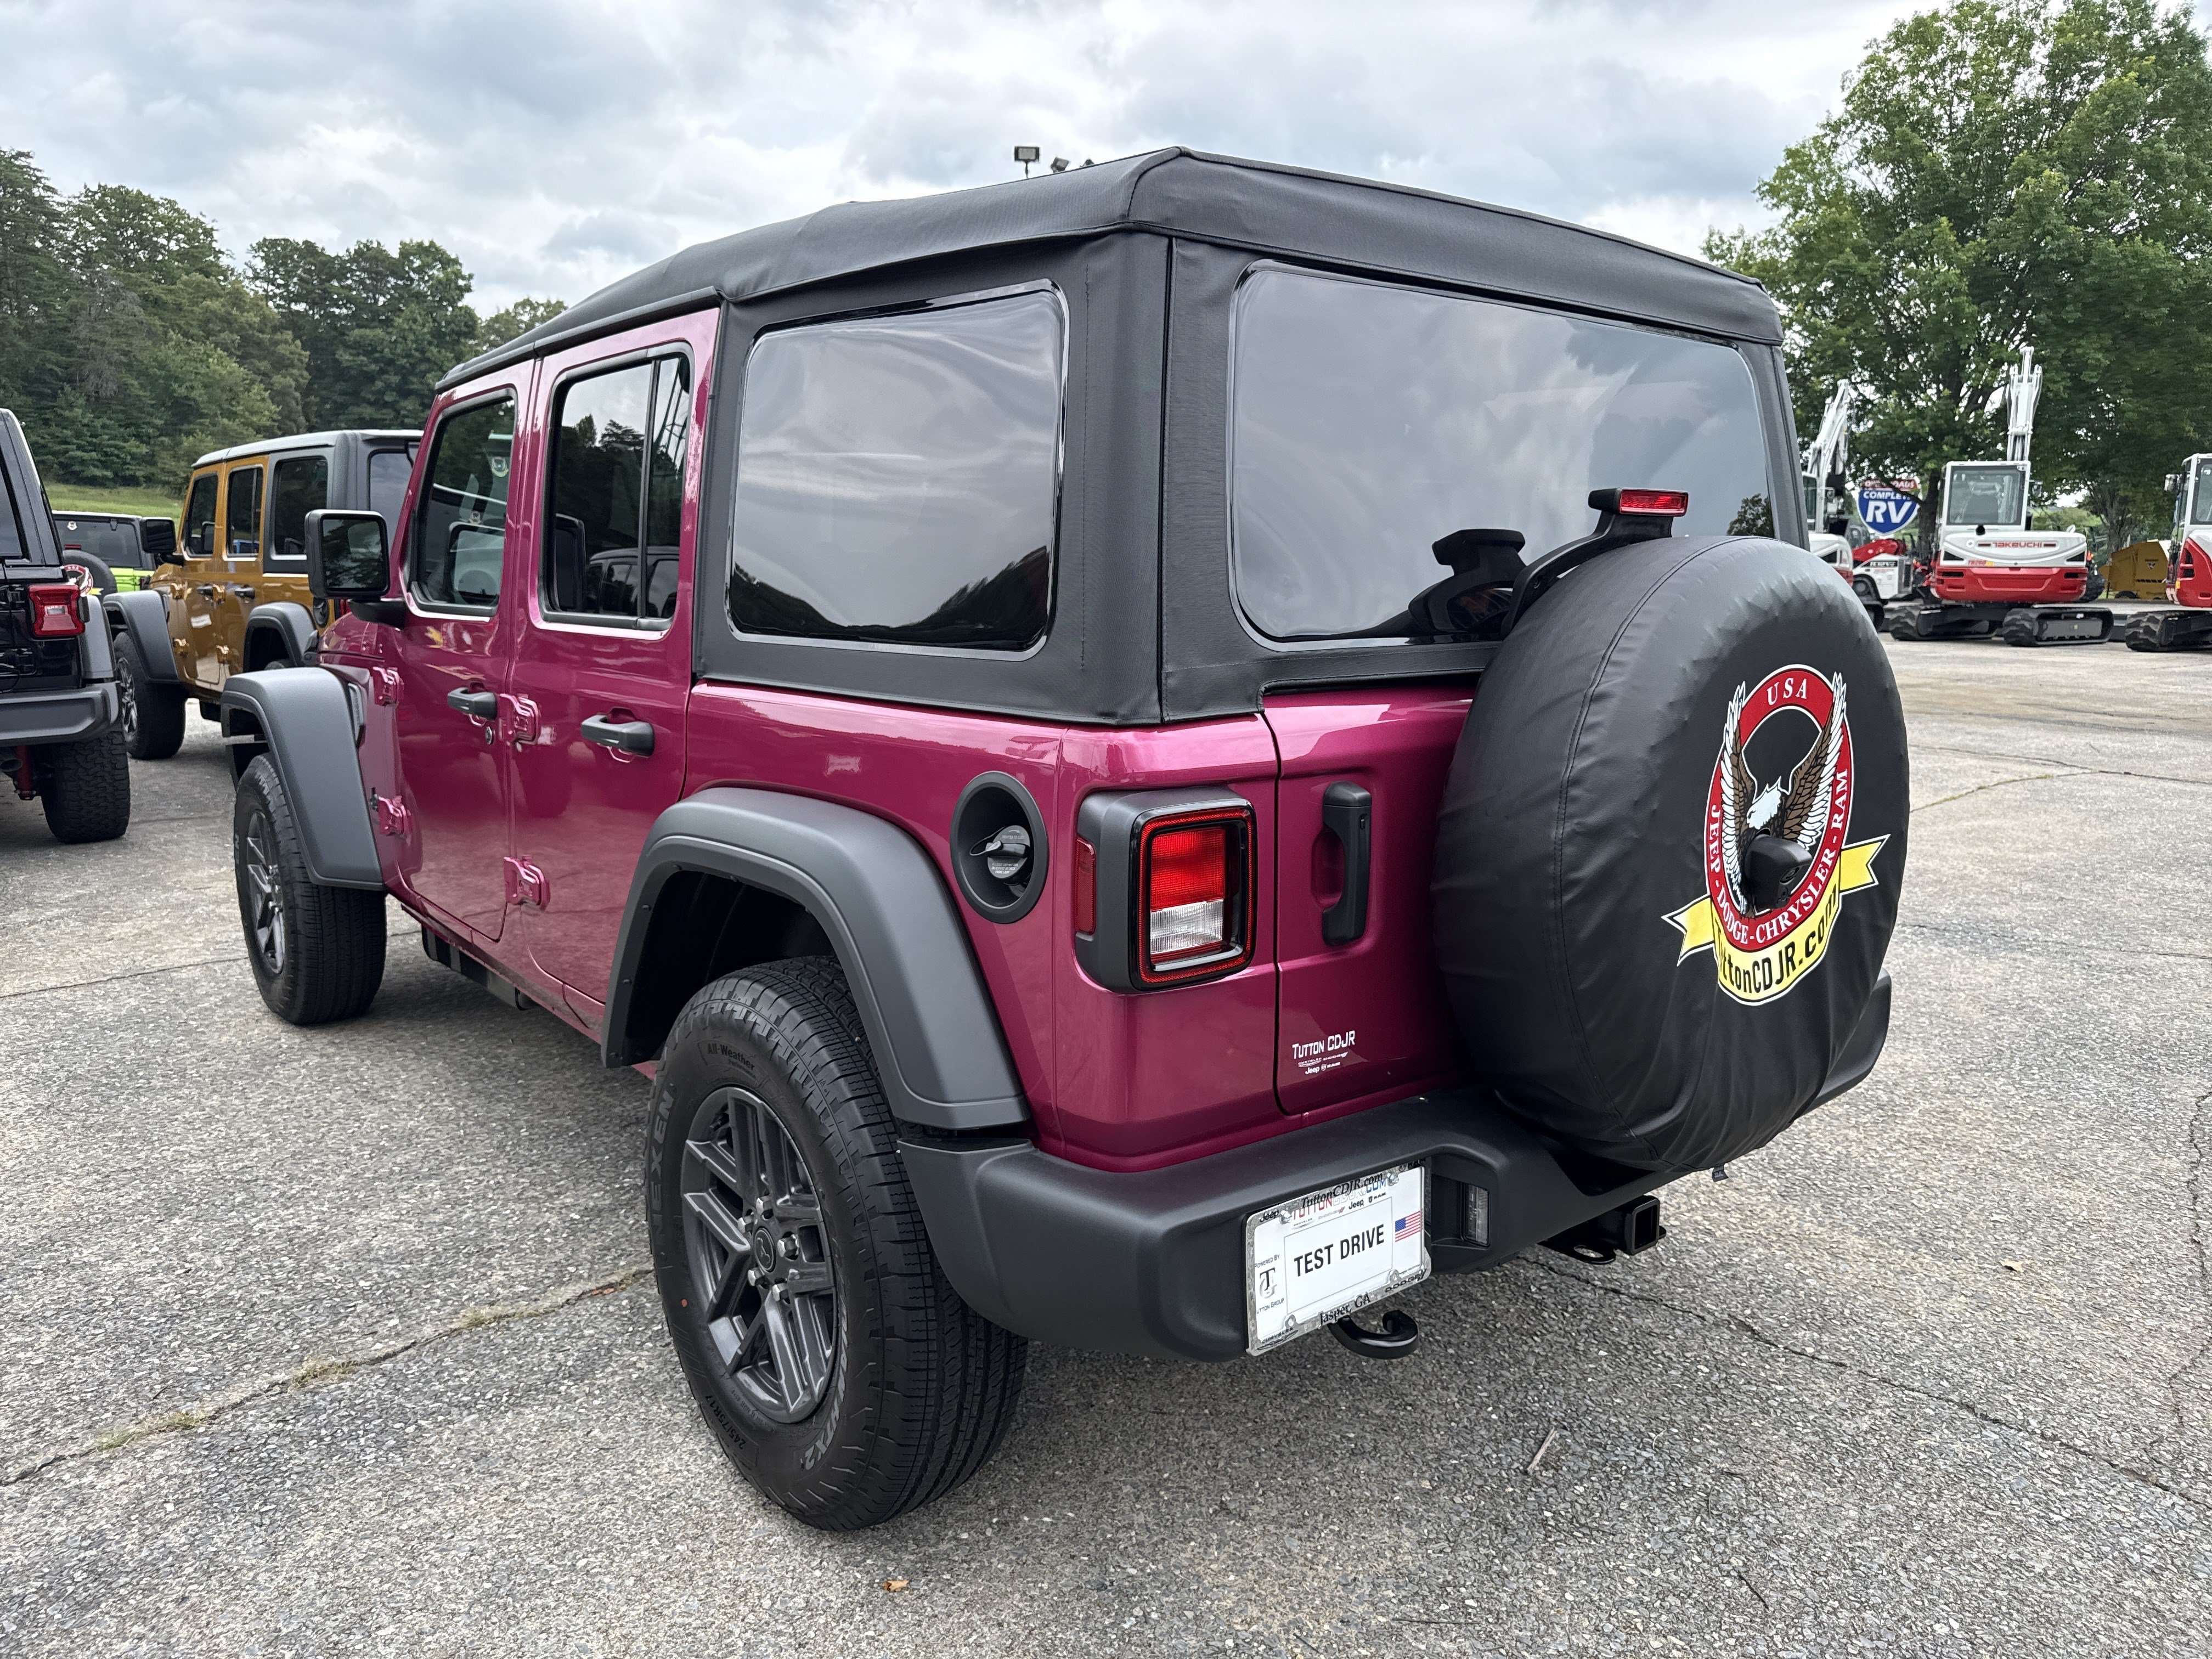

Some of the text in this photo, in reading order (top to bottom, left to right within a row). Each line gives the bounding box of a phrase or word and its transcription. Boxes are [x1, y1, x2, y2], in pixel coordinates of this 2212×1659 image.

[1865, 500, 1912, 523] RV
[1767, 678, 1808, 706] USA
[1711, 768, 1848, 944] JEEP DODGE CHRYSLER RAM
[708, 1043, 755, 1070] All-Weather
[1292, 1030, 1355, 1059] TUTTON CDJR
[1305, 1066, 1320, 1075] Jeep
[1301, 1173, 1383, 1208] TuttonCDJR.com
[1348, 1199, 1364, 1209] Jeep
[1259, 1209, 1279, 1222] Jeep
[1294, 1223, 1385, 1277] TEST DRIVE
[1256, 1304, 1270, 1314] UTTON
[1319, 1292, 1370, 1326] Jasper, GA
